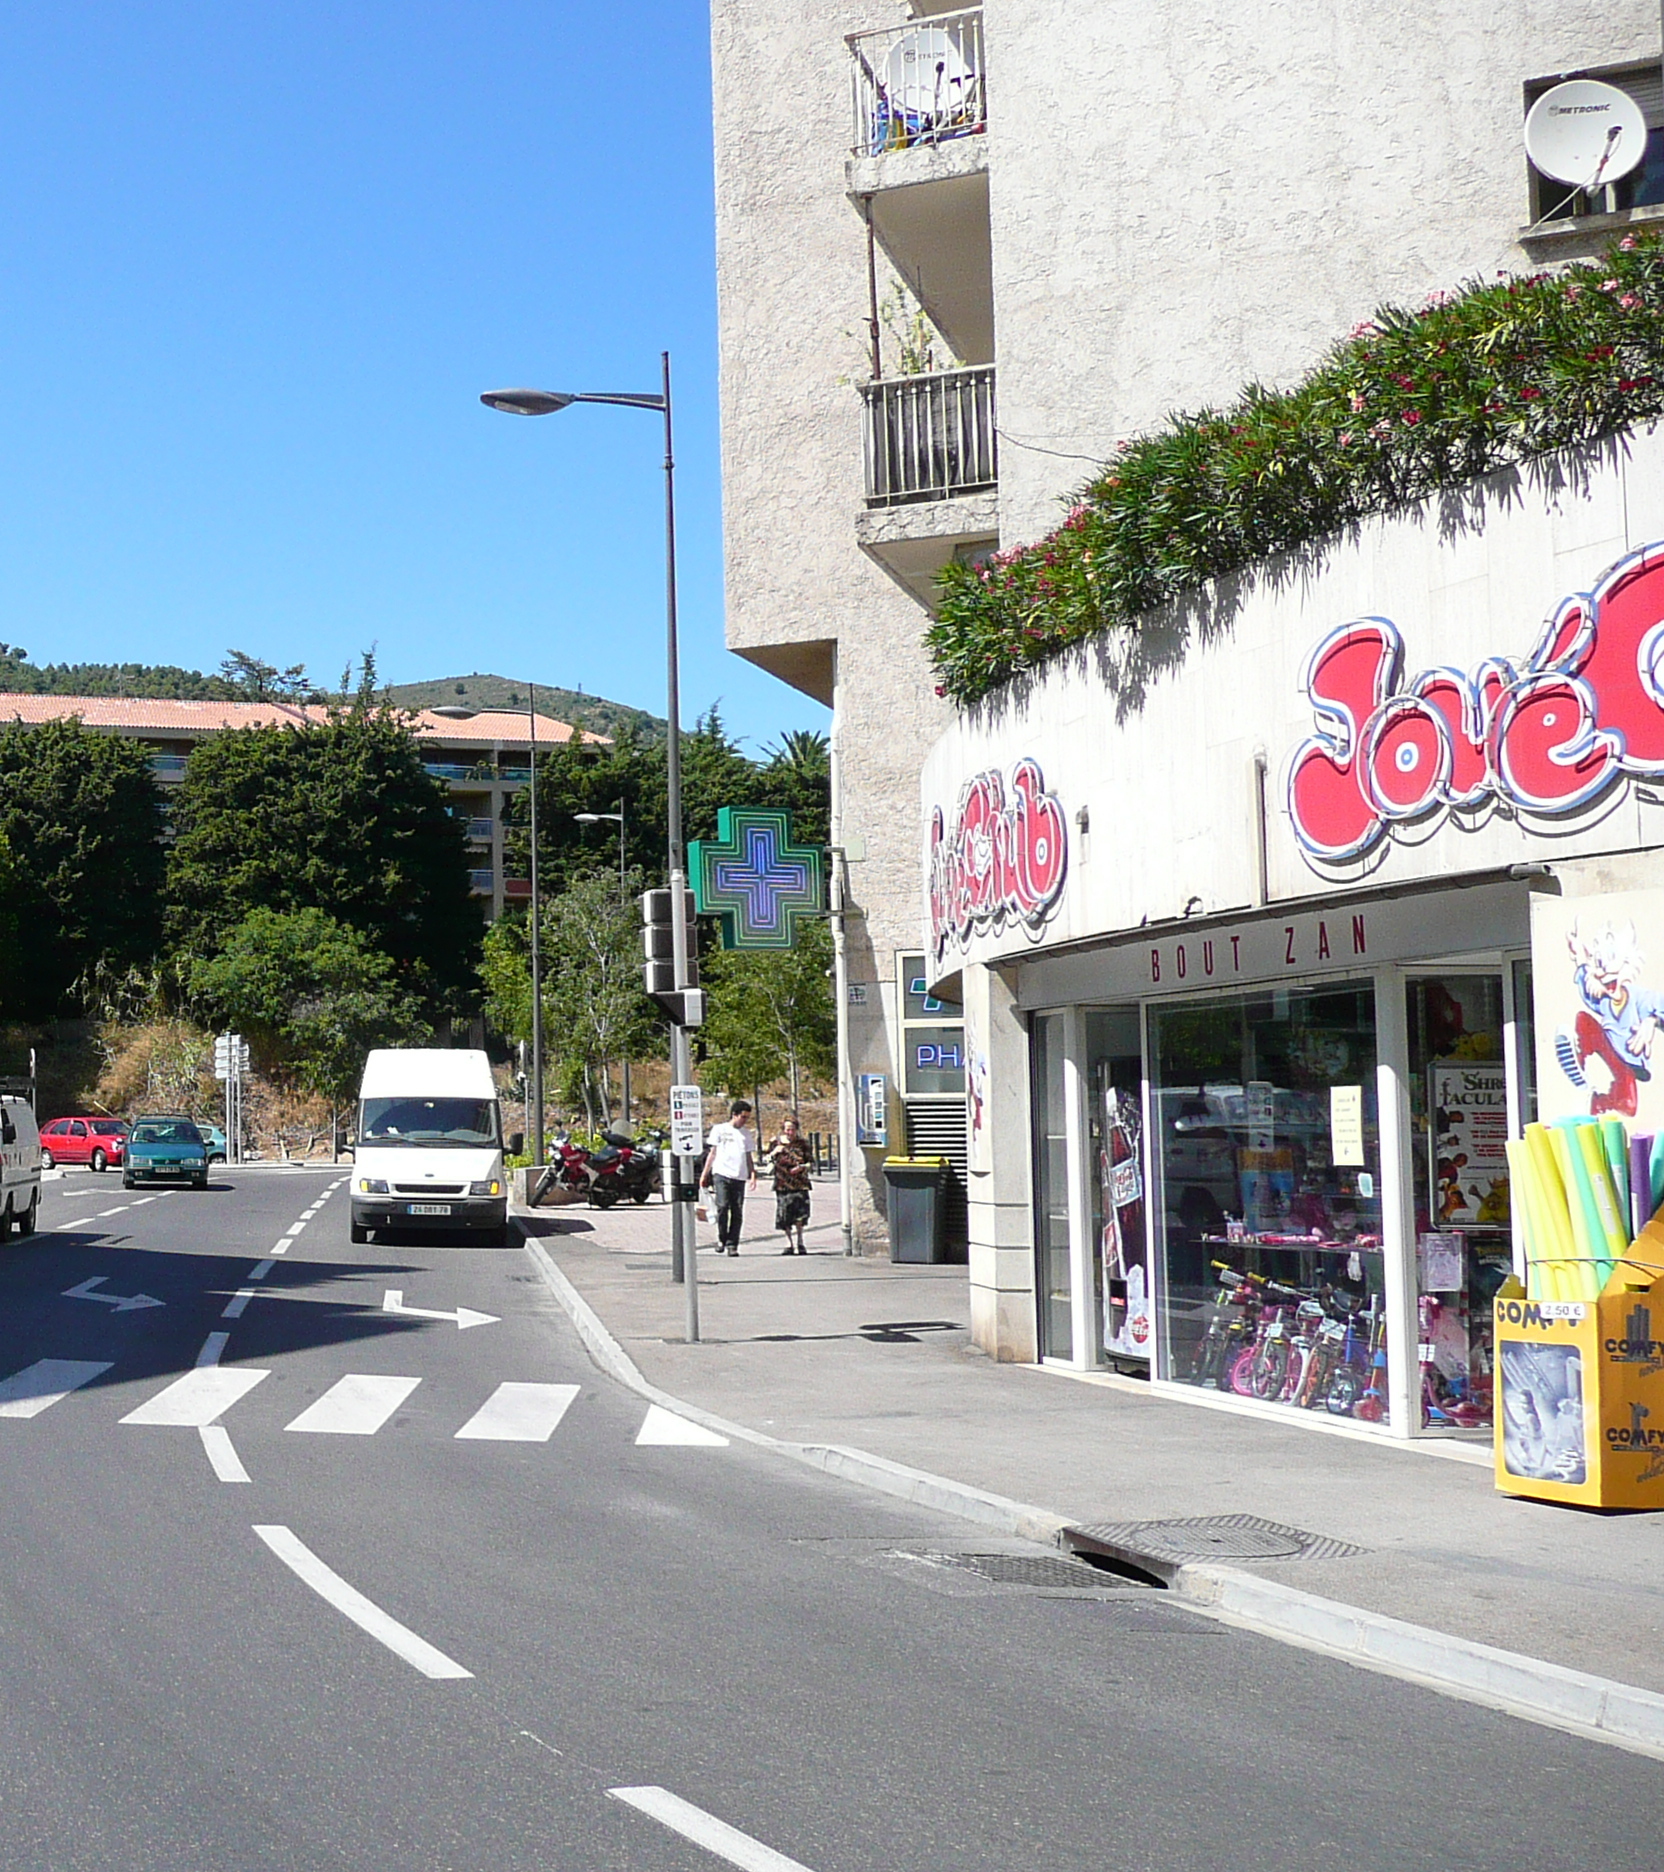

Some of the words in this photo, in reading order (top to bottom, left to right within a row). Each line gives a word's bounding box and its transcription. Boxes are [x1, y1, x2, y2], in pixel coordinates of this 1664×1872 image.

[1558, 103, 1611, 115] METRONIC
[1151, 935, 1240, 982] BOUT
[1285, 914, 1366, 965] ZAN
[917, 1044, 965, 1069] PH
